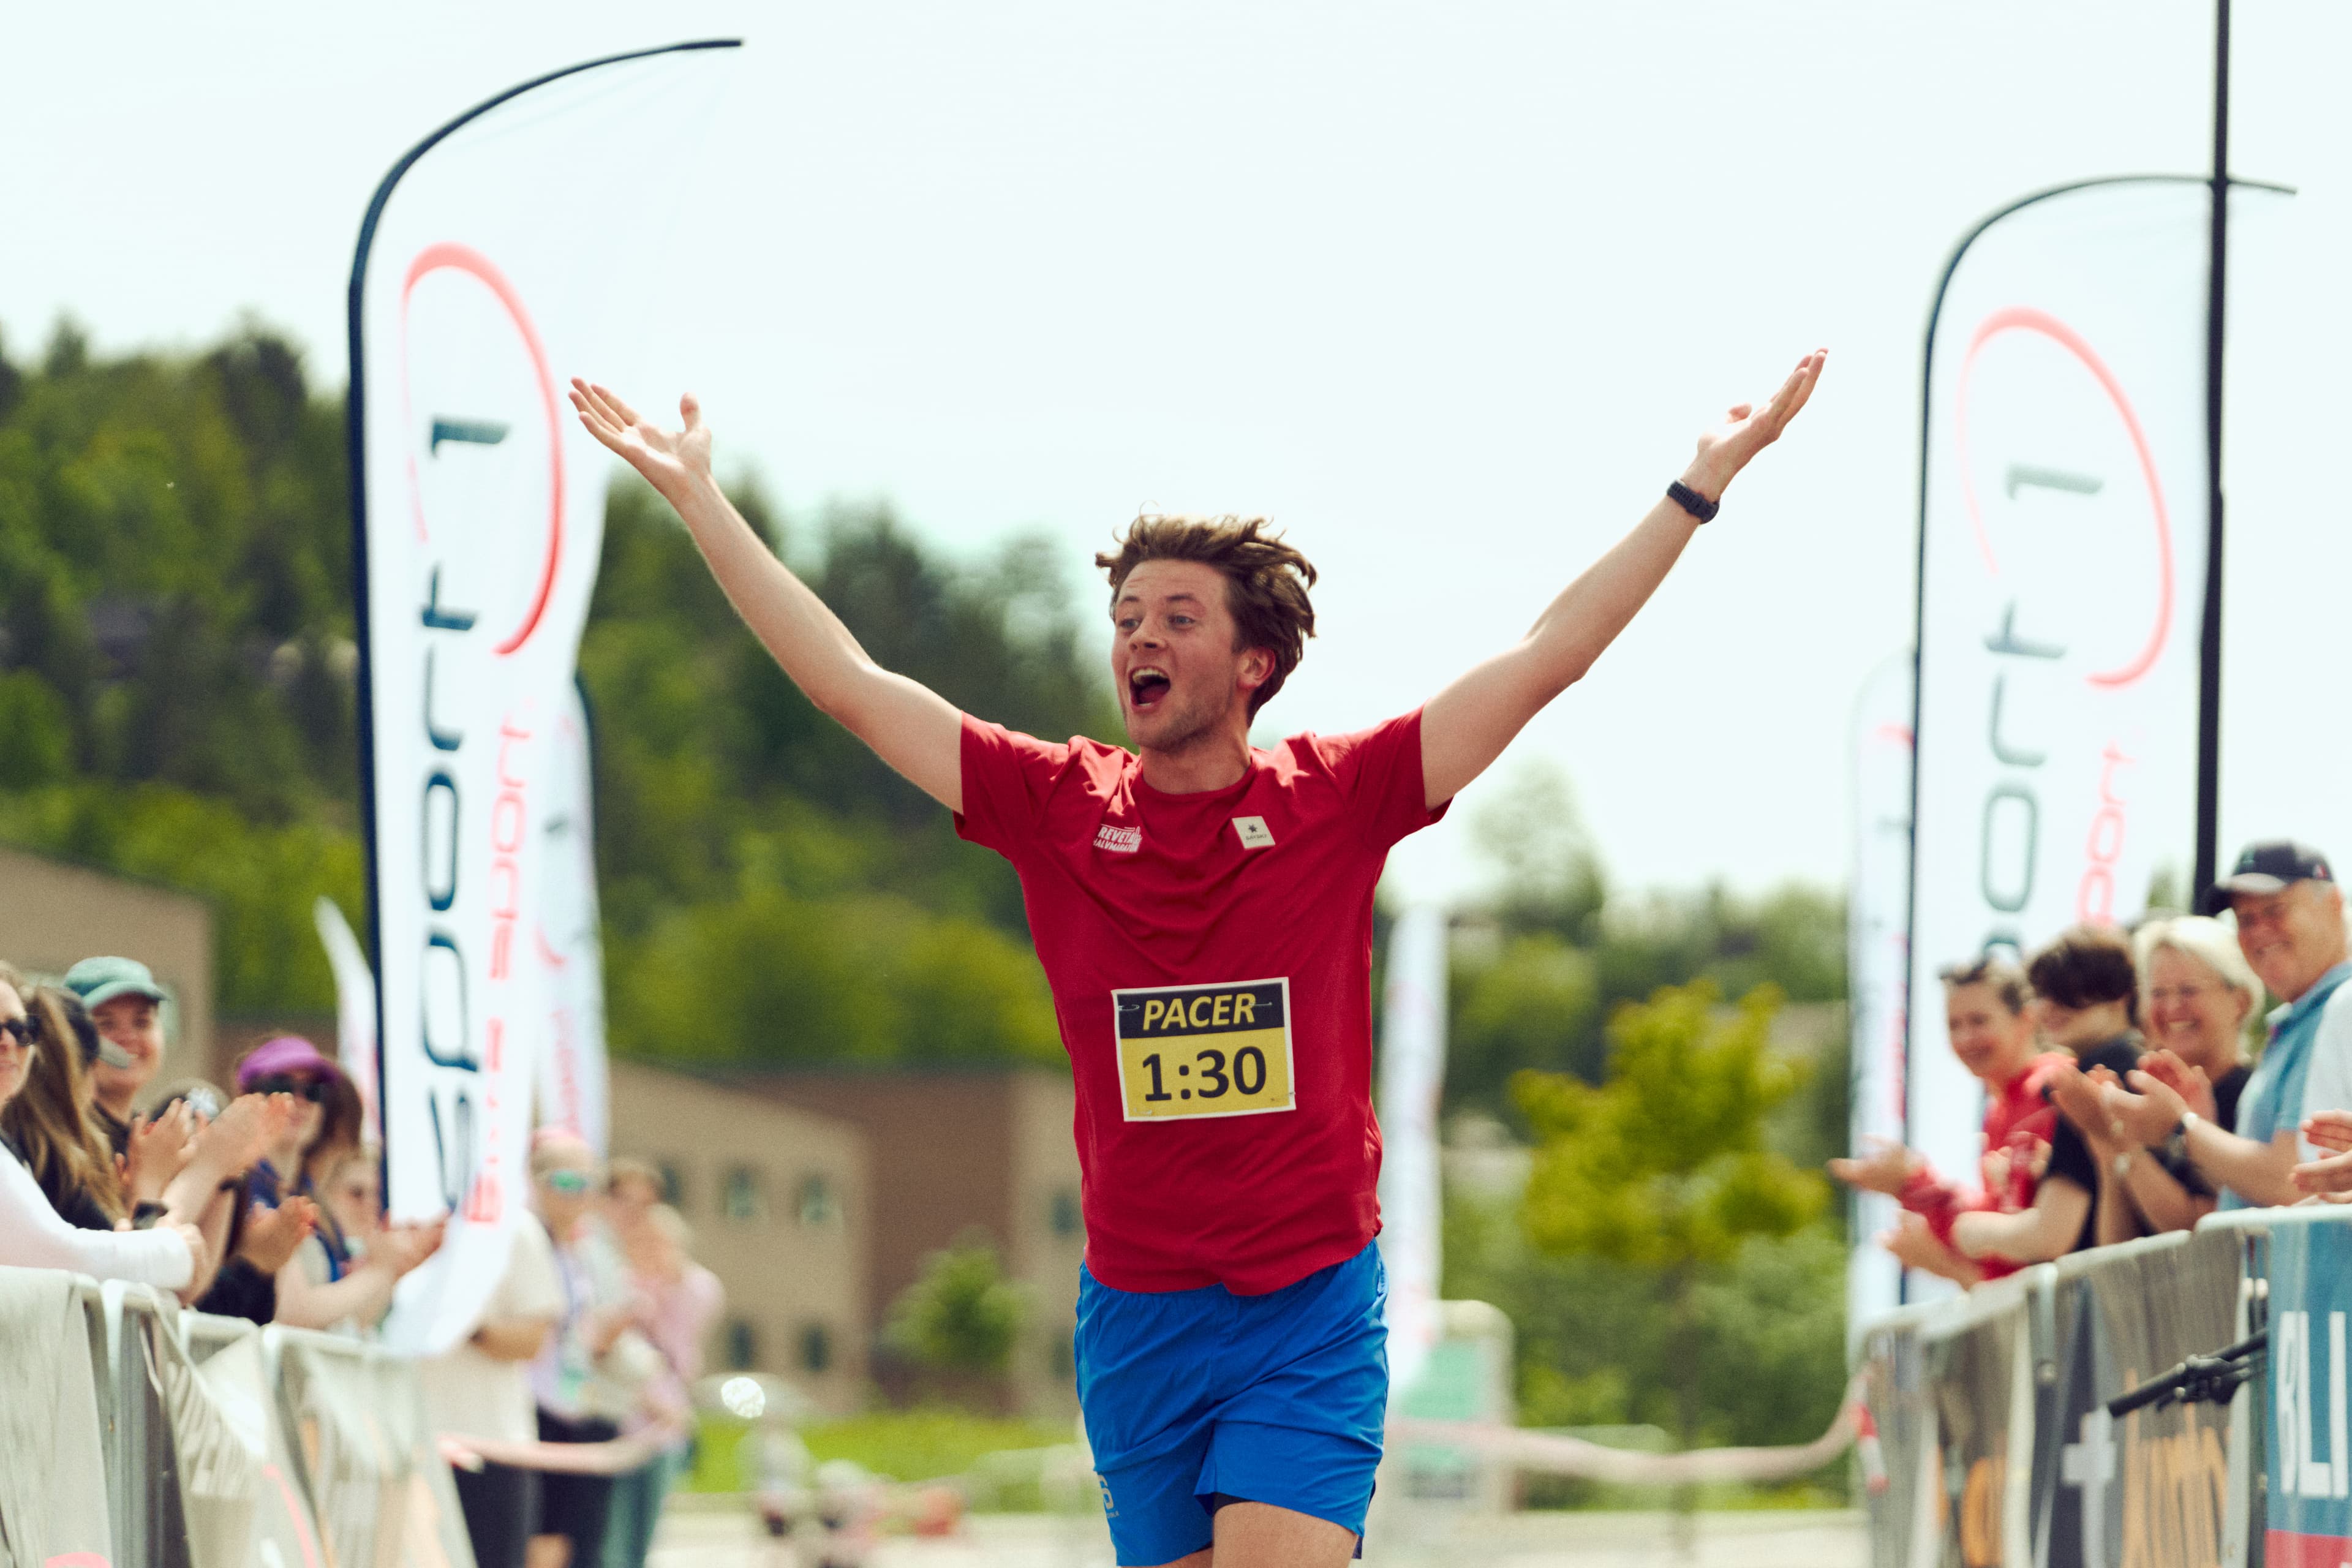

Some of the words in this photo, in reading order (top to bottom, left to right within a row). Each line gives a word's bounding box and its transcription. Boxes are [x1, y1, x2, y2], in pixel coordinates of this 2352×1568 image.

[431, 415, 510, 458] 1
[2006, 463, 2104, 501] 1
[1981, 598, 2067, 962] ort
[1142, 992, 1256, 1031] PACER
[1142, 1046, 1267, 1101] 1:30
